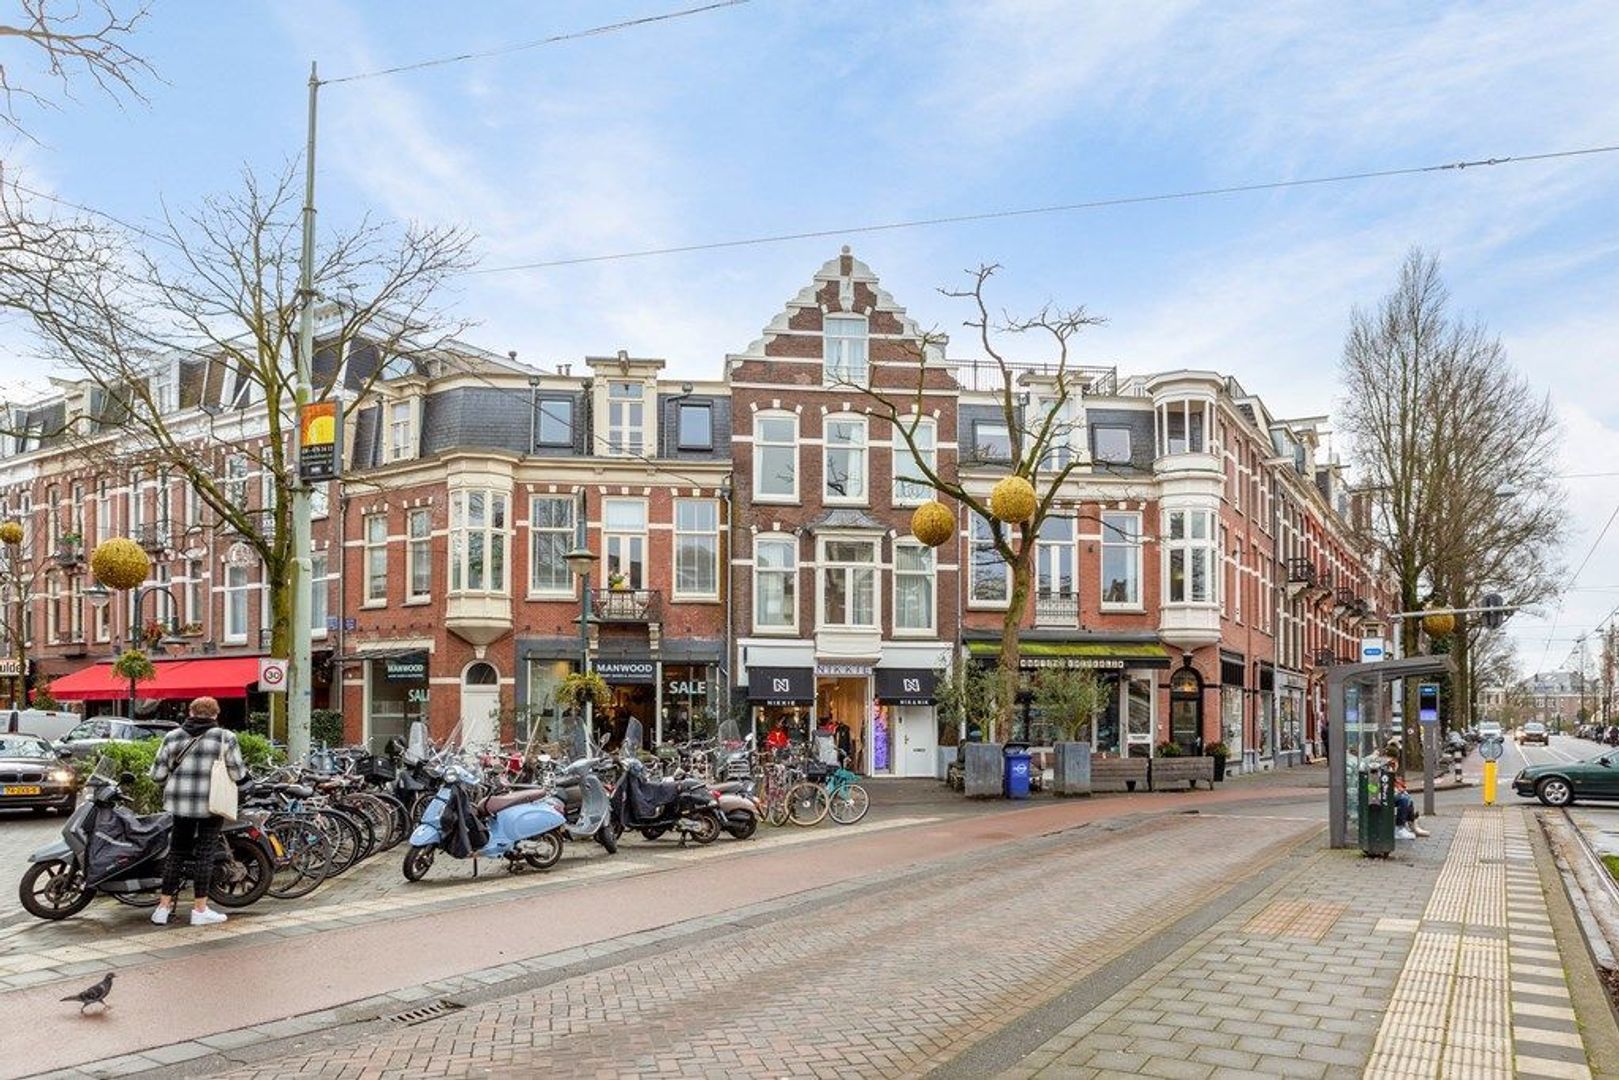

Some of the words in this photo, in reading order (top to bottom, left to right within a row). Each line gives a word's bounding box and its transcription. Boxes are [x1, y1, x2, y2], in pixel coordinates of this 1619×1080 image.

[387, 664, 424, 673] MANWOOD
[597, 663, 653, 673] MANWOOD
[267, 671, 280, 680] 30
[669, 681, 706, 694] SALE
[408, 689, 430, 702] SAL
